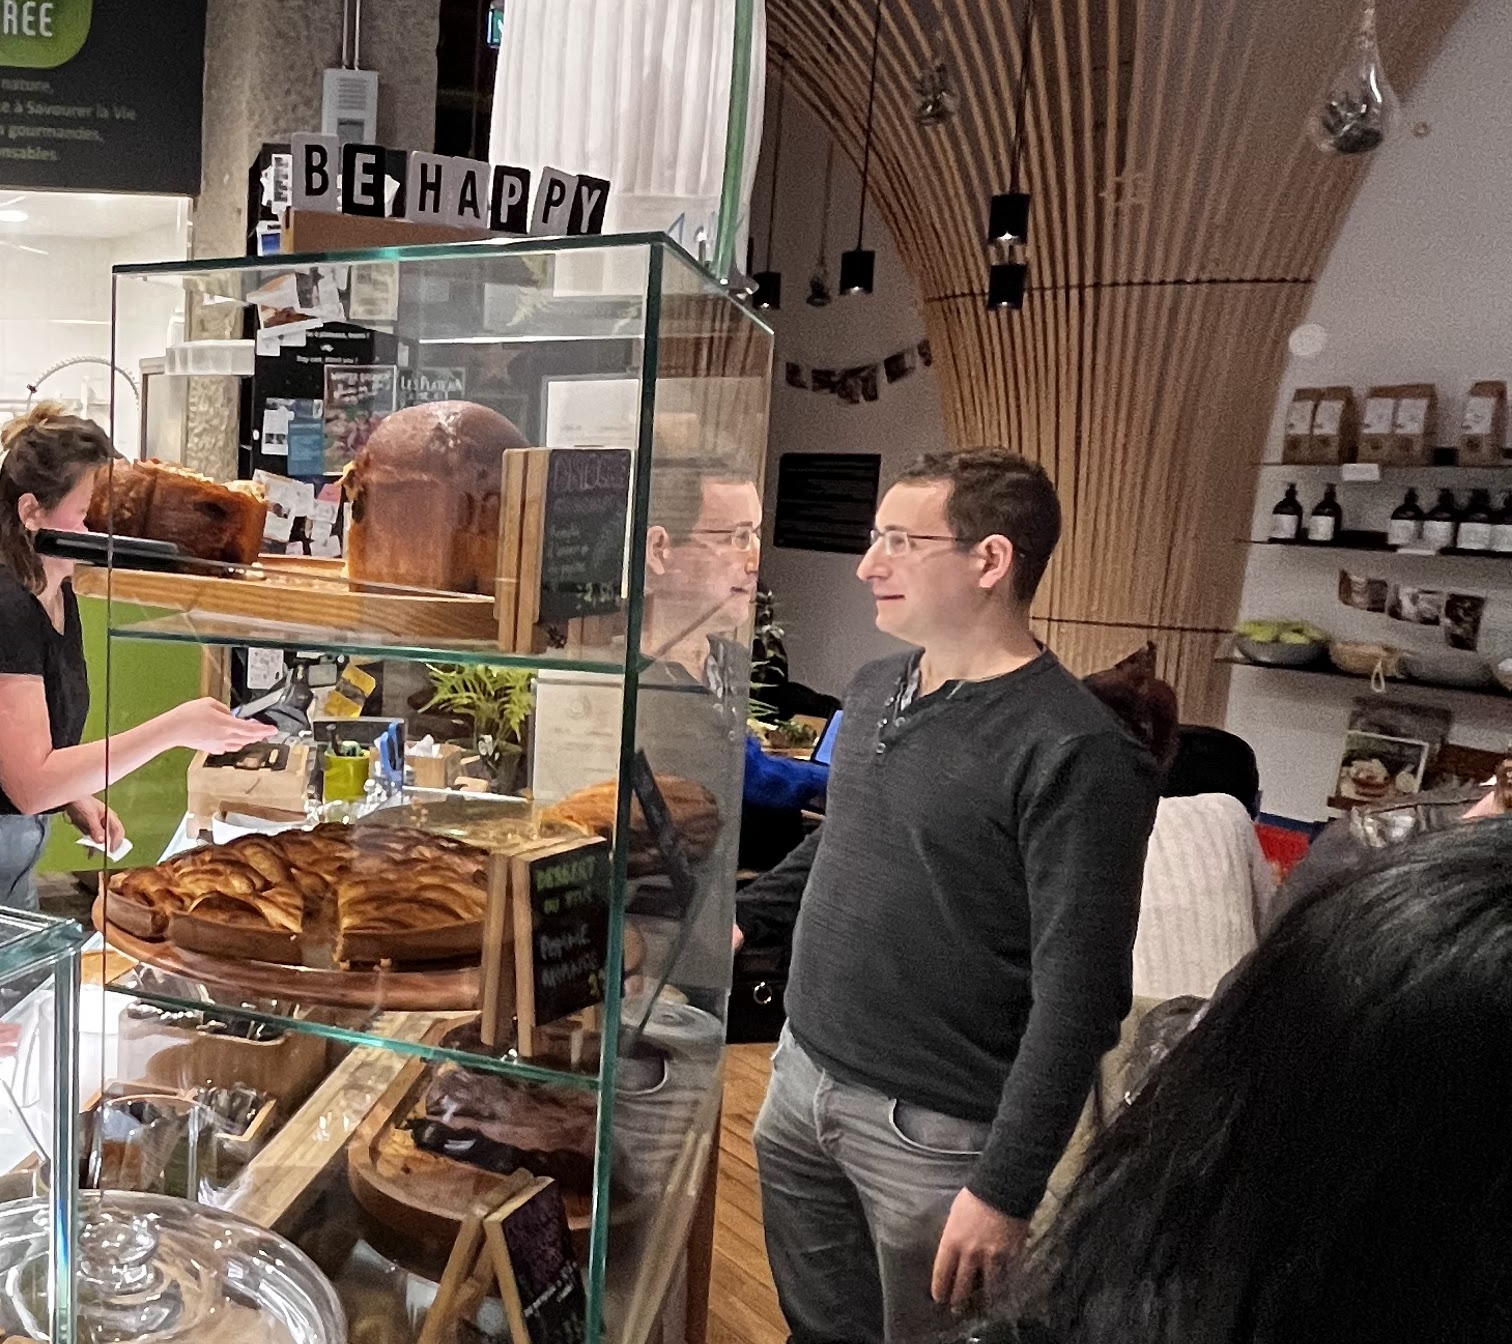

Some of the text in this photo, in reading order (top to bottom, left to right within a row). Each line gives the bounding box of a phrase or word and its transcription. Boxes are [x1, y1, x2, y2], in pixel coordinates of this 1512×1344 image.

[13, 98, 24, 114] à
[26, 100, 92, 120] Savourer
[95, 102, 110, 119] la
[112, 104, 137, 122] Vie
[304, 143, 602, 233] BE HAPPY
